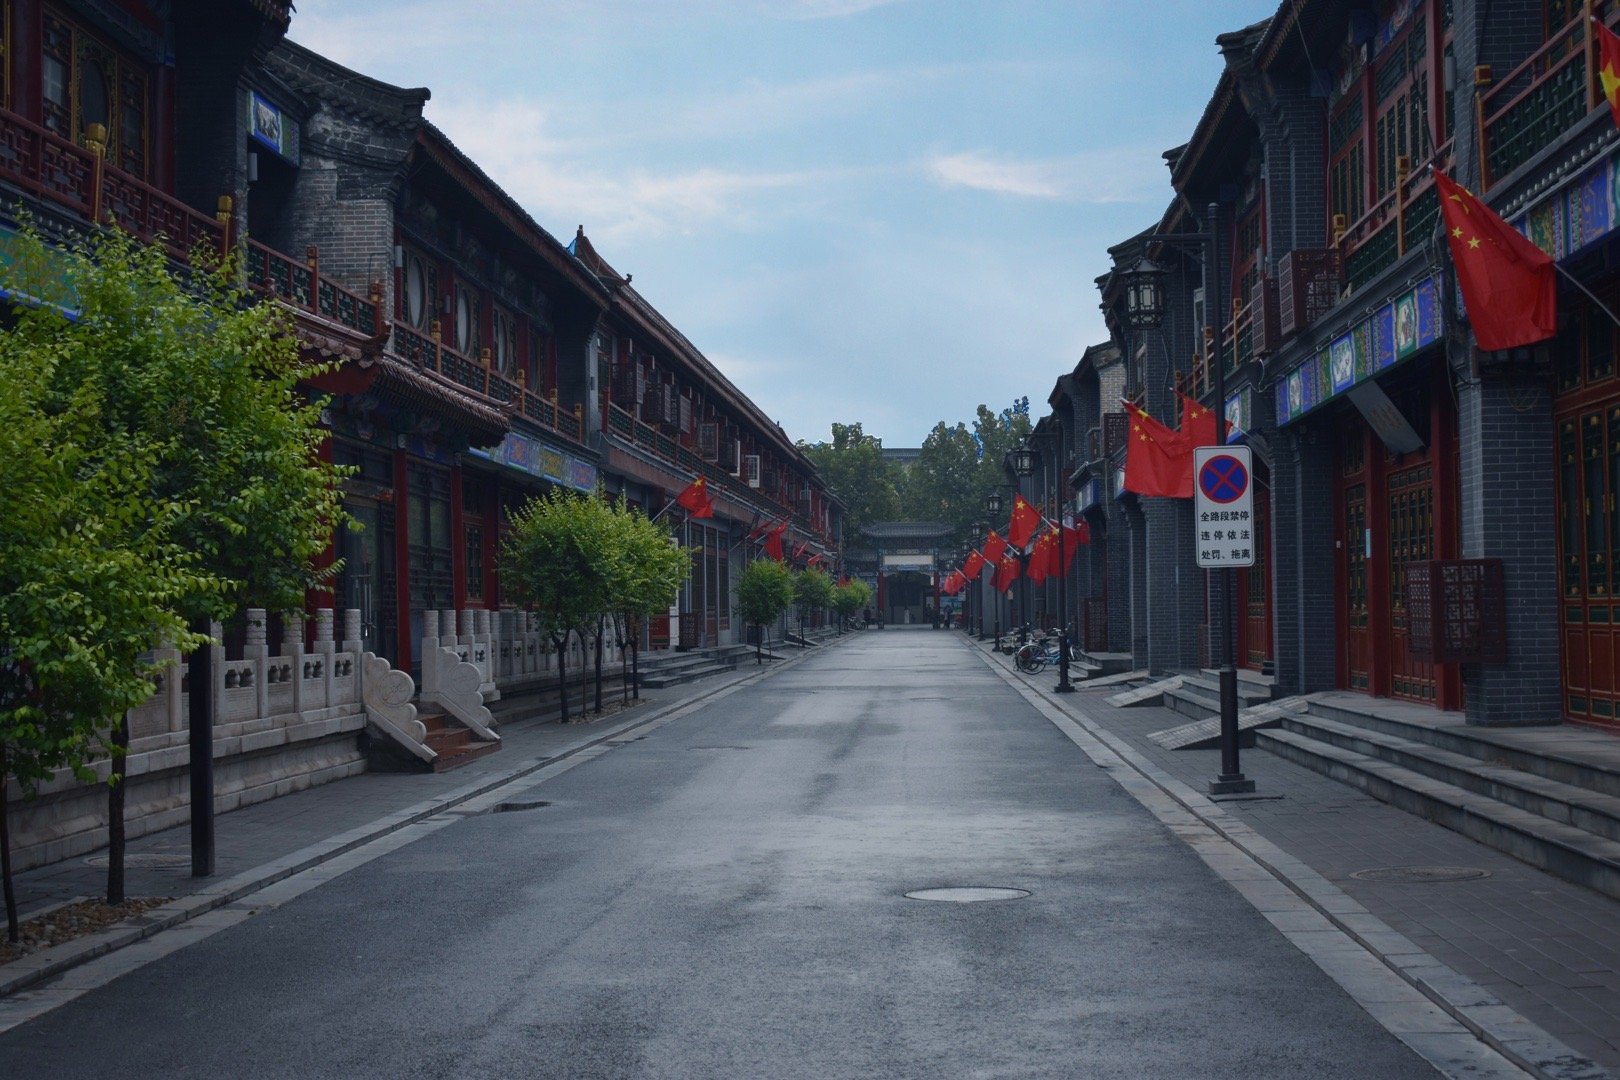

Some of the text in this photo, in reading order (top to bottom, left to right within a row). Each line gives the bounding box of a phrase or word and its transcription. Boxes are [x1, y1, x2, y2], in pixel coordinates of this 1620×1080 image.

[1200, 511, 1249, 522] 全路段禁停
[1201, 530, 1250, 541] 违停依法
[1201, 549, 1250, 560] 处罚、拖离
